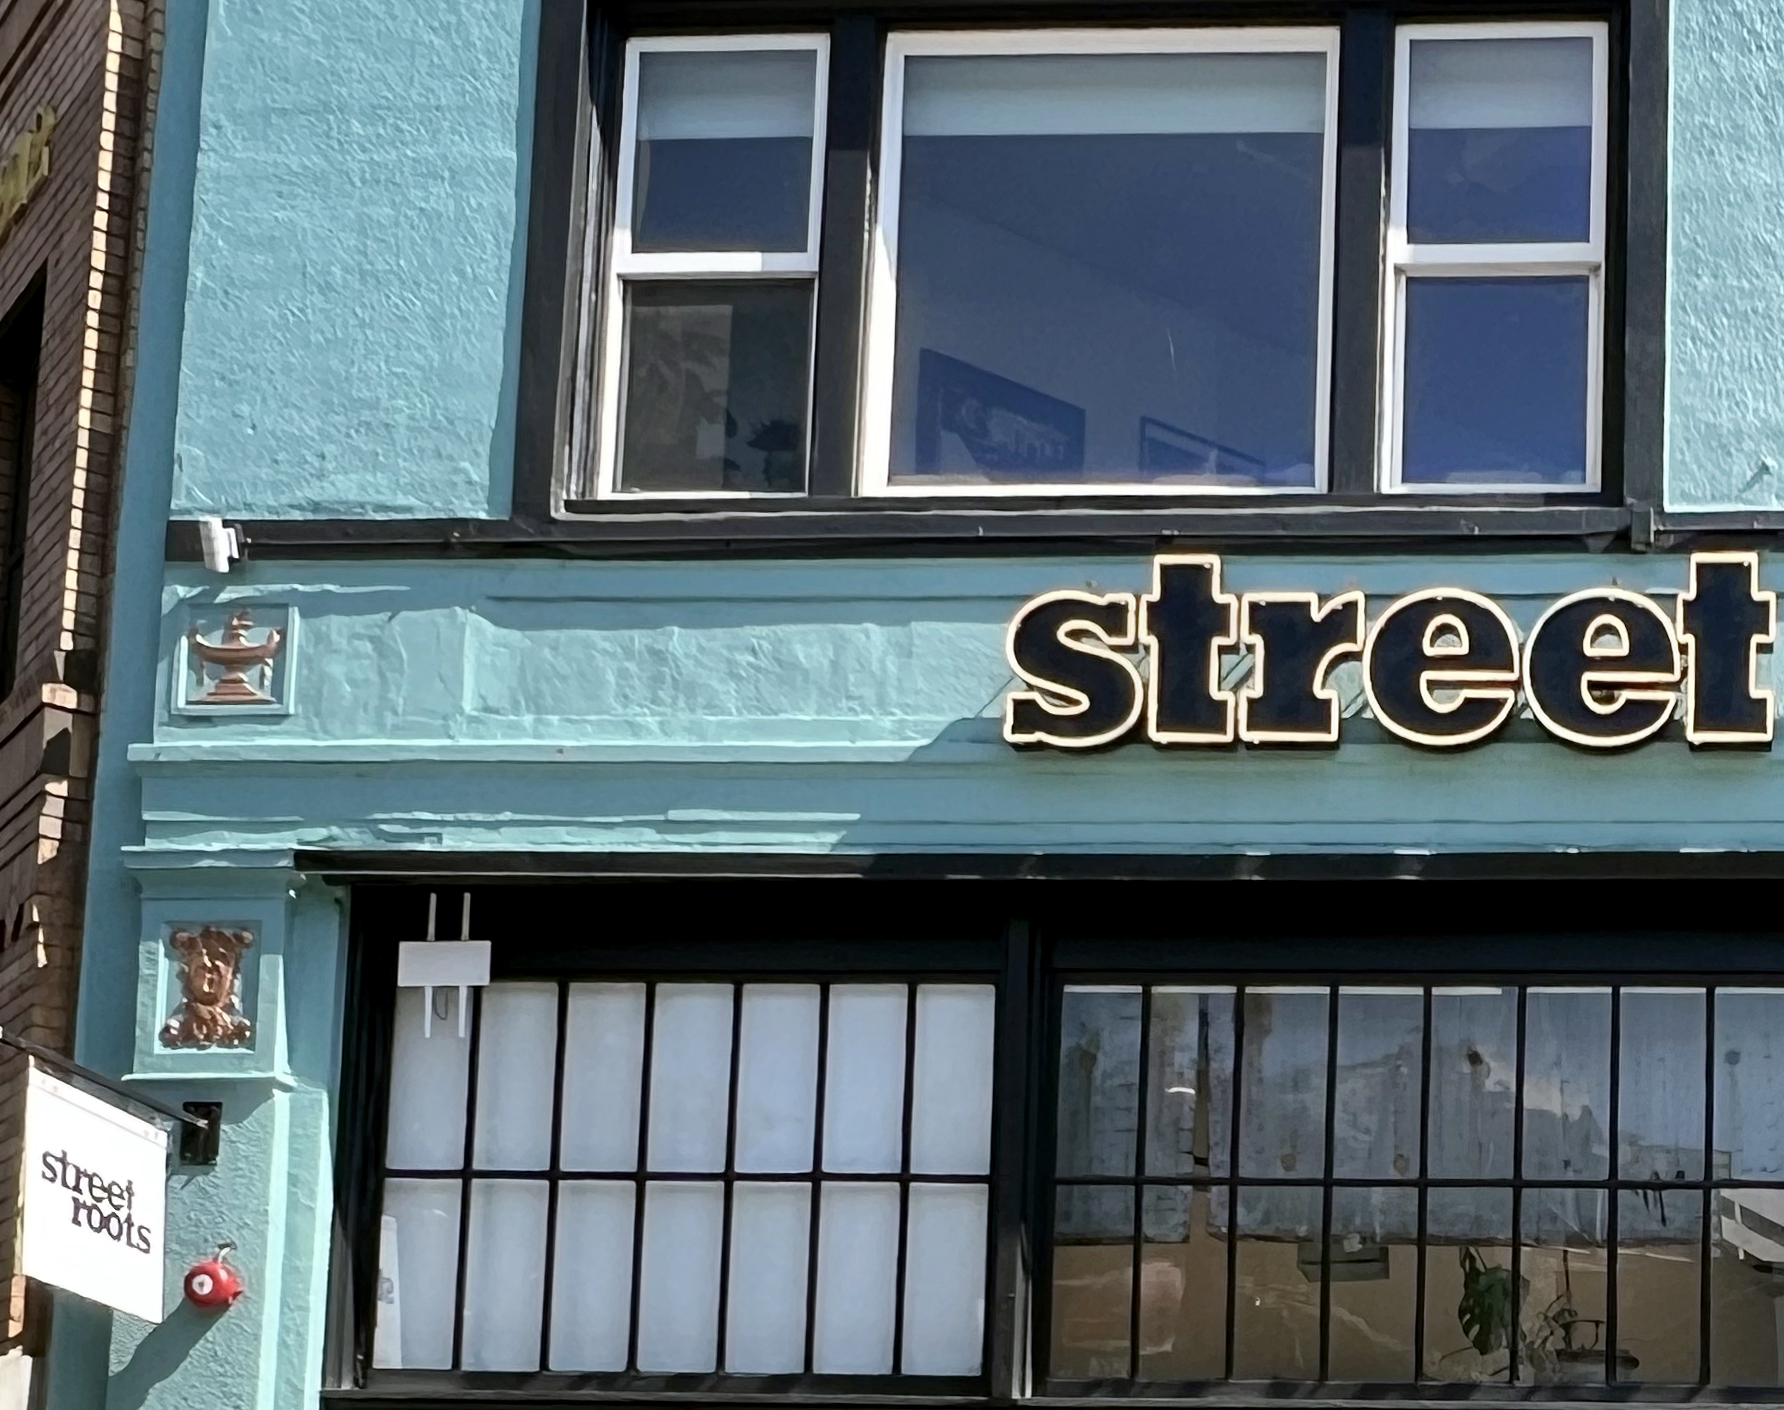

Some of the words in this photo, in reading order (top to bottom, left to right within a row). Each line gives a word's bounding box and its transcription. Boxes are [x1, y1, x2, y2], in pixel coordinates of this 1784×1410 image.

[1003, 552, 1776, 748] street
[41, 1149, 135, 1211] street
[71, 1196, 152, 1254] roots
